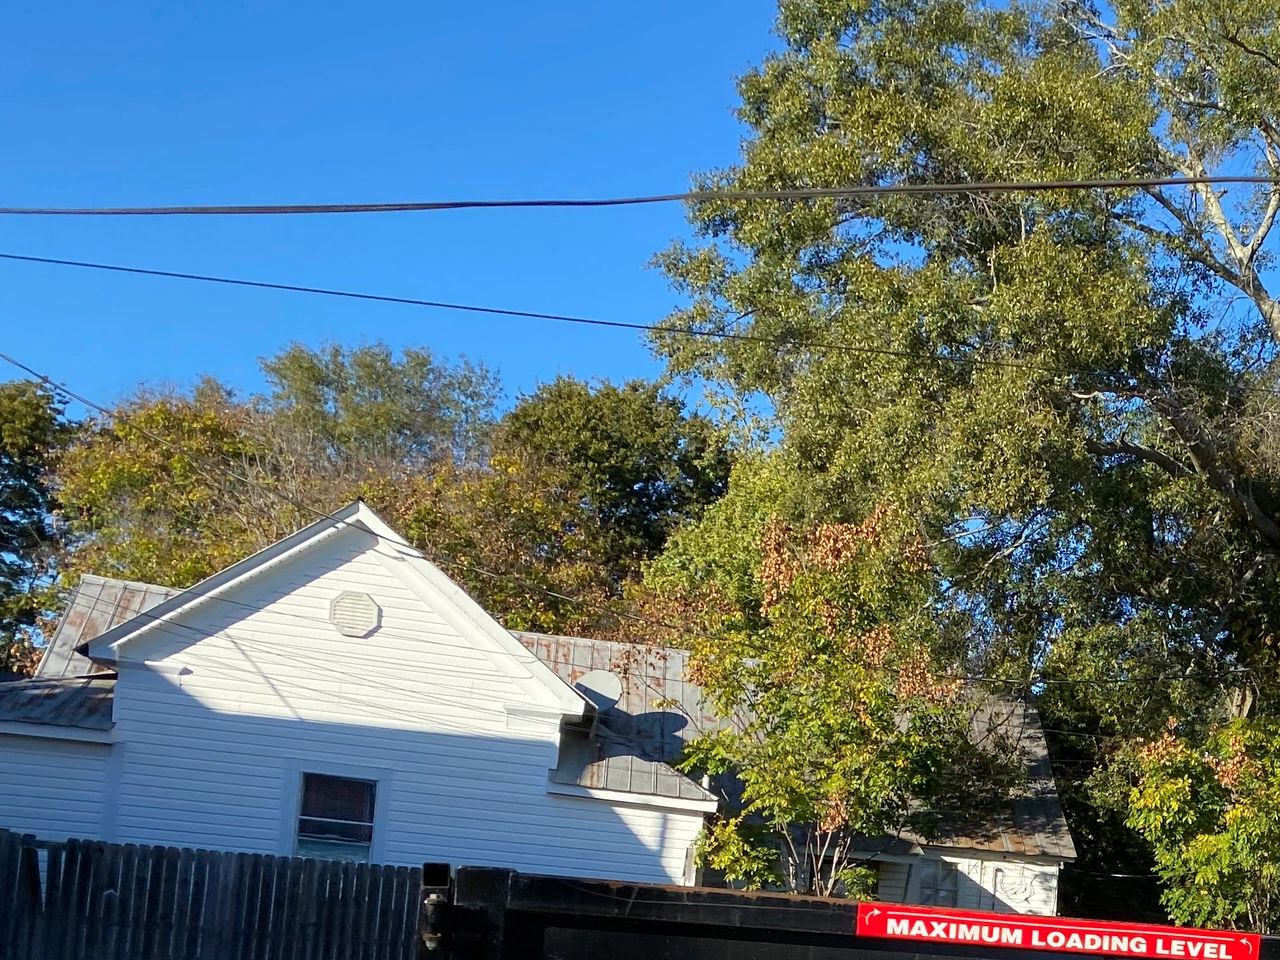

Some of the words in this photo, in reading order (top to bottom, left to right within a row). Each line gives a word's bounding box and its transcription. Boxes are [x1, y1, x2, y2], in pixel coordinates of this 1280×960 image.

[886, 918, 1022, 945] MAXIMUM
[1031, 929, 1147, 953] LOADING
[1155, 937, 1233, 960] LEVEL
